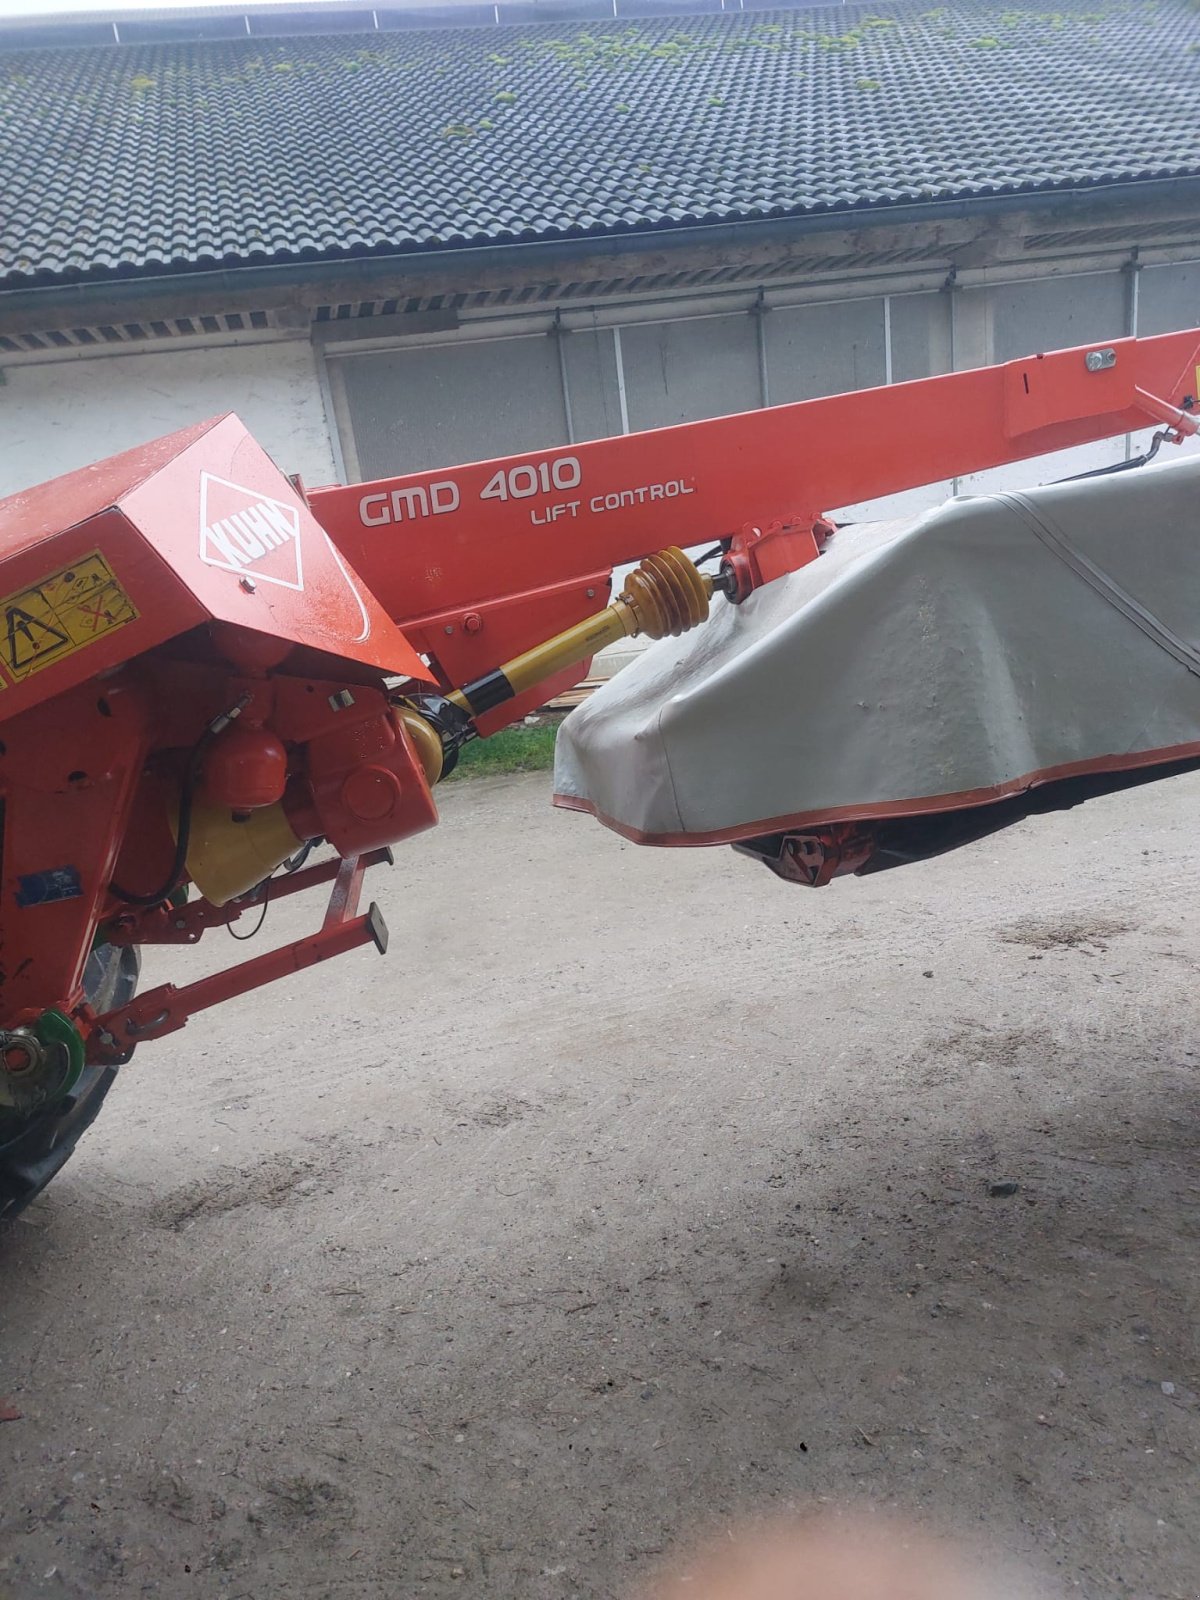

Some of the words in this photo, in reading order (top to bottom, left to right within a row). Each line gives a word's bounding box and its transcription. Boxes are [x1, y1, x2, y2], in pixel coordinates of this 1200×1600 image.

[359, 480, 460, 527] GMD
[480, 456, 582, 501] 4010
[530, 500, 581, 525] LIFT
[590, 479, 694, 513] CONTROL
[204, 499, 297, 568] KUHN
